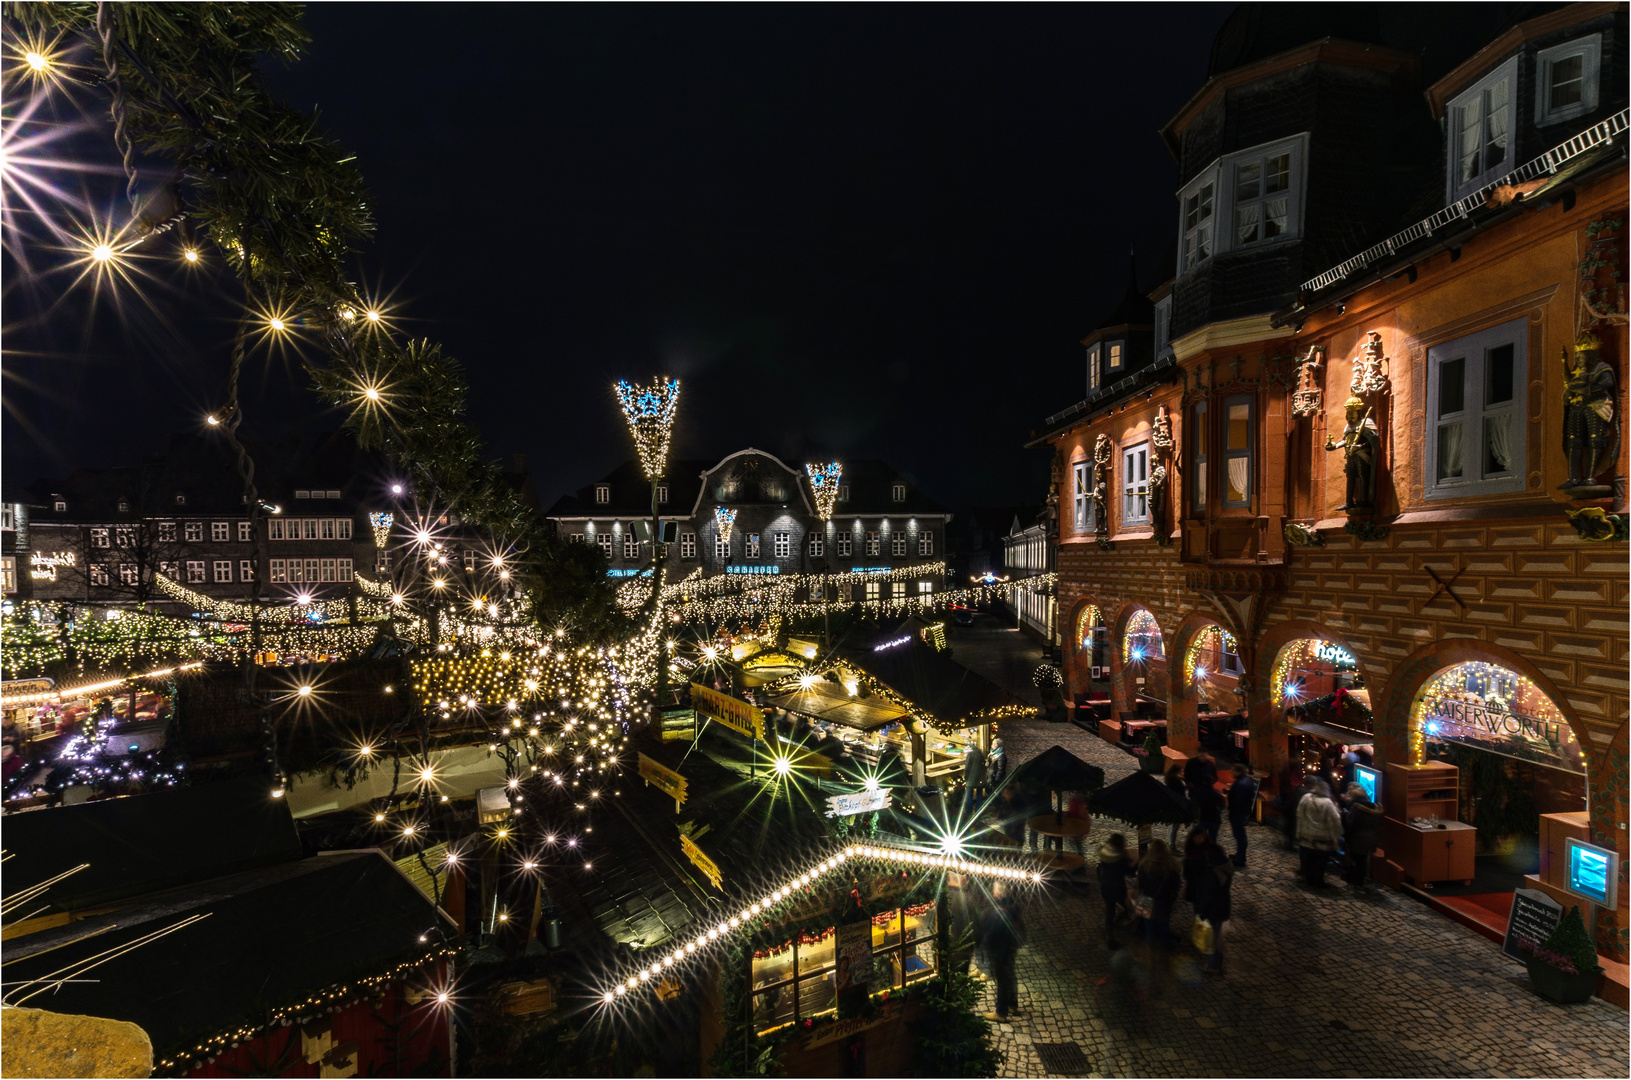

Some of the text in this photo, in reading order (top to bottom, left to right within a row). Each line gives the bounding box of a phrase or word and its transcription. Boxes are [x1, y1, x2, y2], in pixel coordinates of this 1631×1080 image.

[702, 691, 752, 732] HARZ-GRILL
[1434, 701, 1560, 743] KAISERWORTH
[1508, 702, 1551, 719] Hotel
